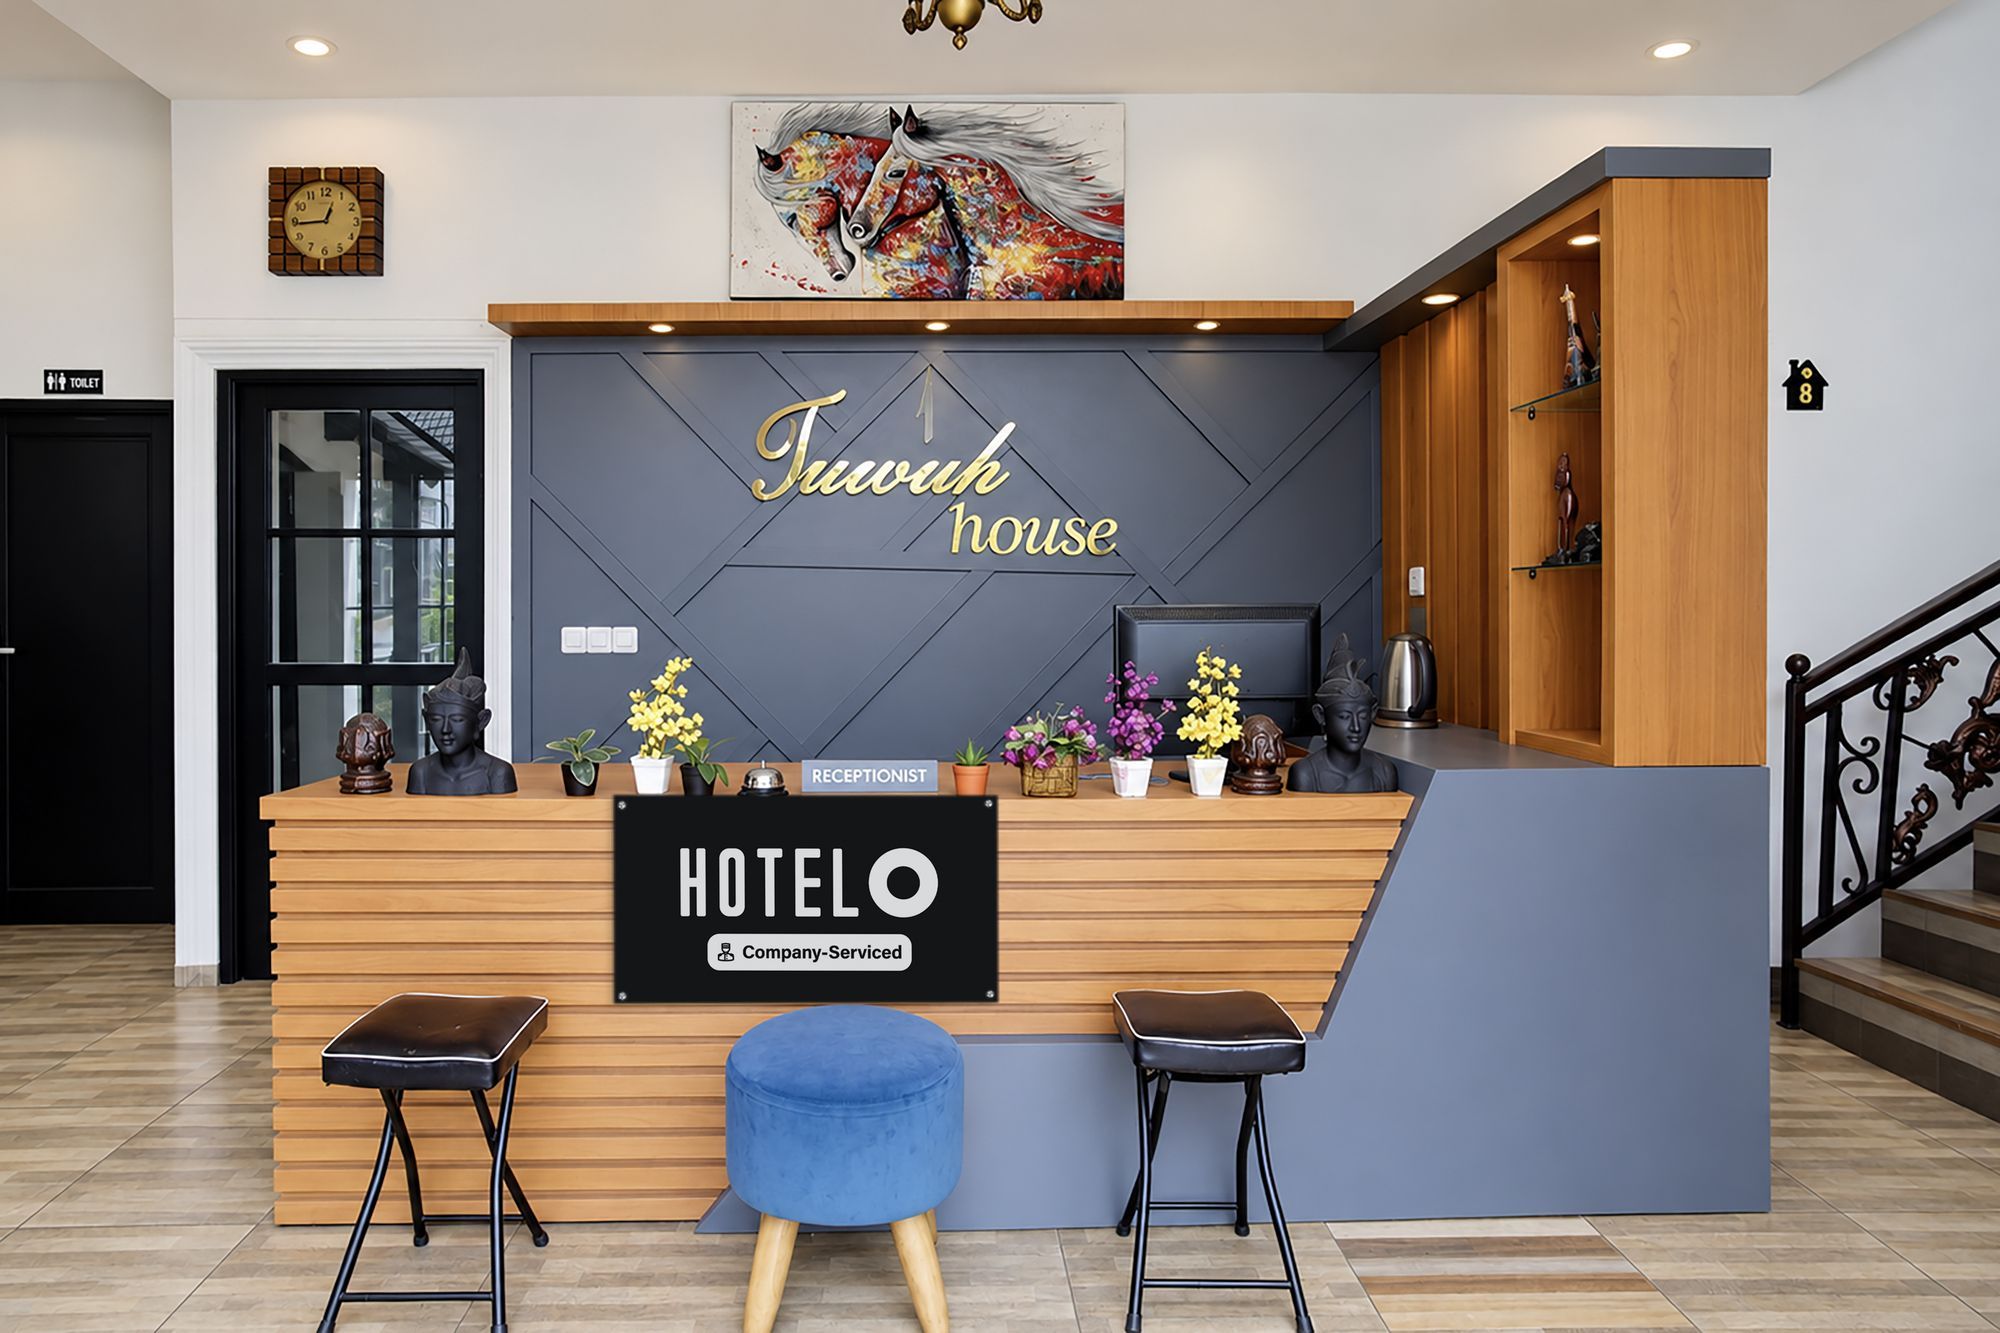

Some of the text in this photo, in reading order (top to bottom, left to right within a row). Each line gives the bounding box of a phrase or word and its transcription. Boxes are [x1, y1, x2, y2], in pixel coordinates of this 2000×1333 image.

[306, 191, 316, 201] 11
[320, 187, 332, 198] 12
[339, 191, 344, 200] 1
[348, 202, 356, 212] 2
[353, 217, 360, 227] 3
[307, 242, 314, 251] 7
[321, 246, 329, 256] 6
[336, 243, 343, 253] 5
[69, 377, 100, 388] TOILET
[1799, 382, 1813, 404] 8
[750, 388, 1016, 501] Tuwuh
[948, 501, 1118, 556] house
[811, 767, 928, 784] RECEPTIONIST
[742, 944, 903, 963] Company-Serviced
